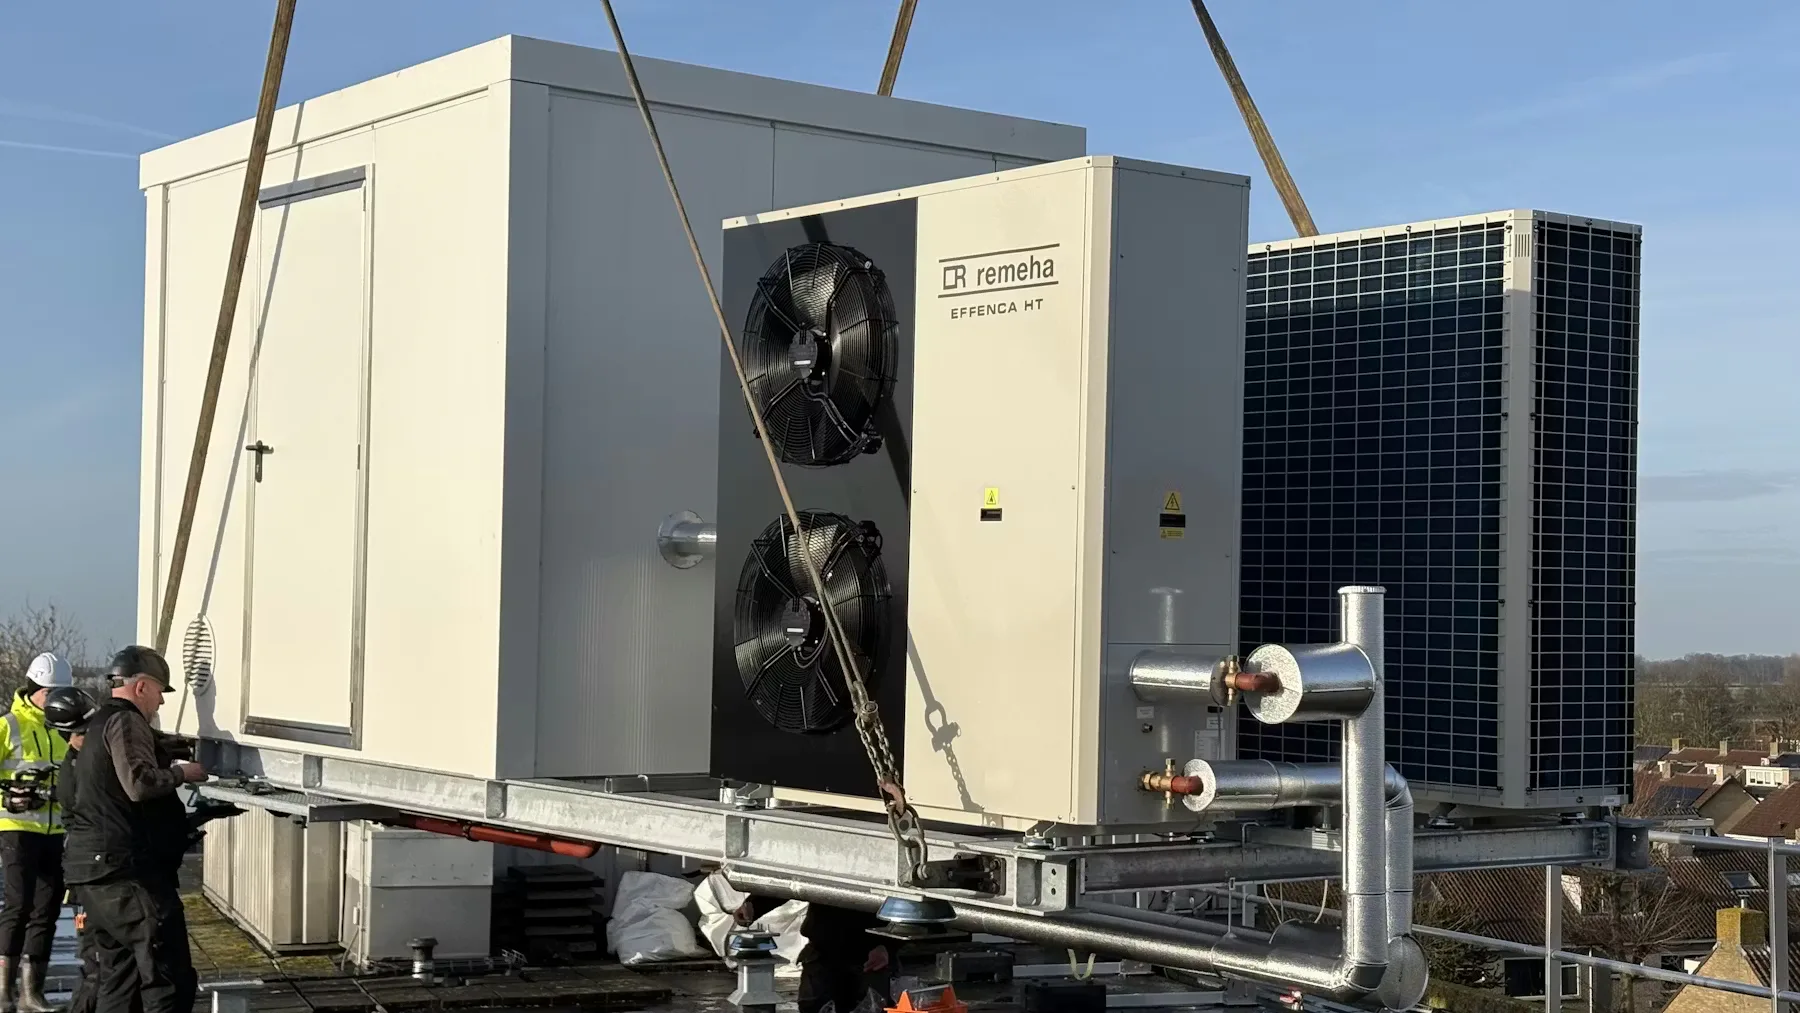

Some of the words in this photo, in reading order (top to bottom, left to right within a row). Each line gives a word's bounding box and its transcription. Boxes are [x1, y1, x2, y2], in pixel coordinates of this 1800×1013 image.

[977, 255, 1054, 286] remeha
[951, 302, 1017, 319] EFFENCA
[1024, 299, 1043, 311] HT
